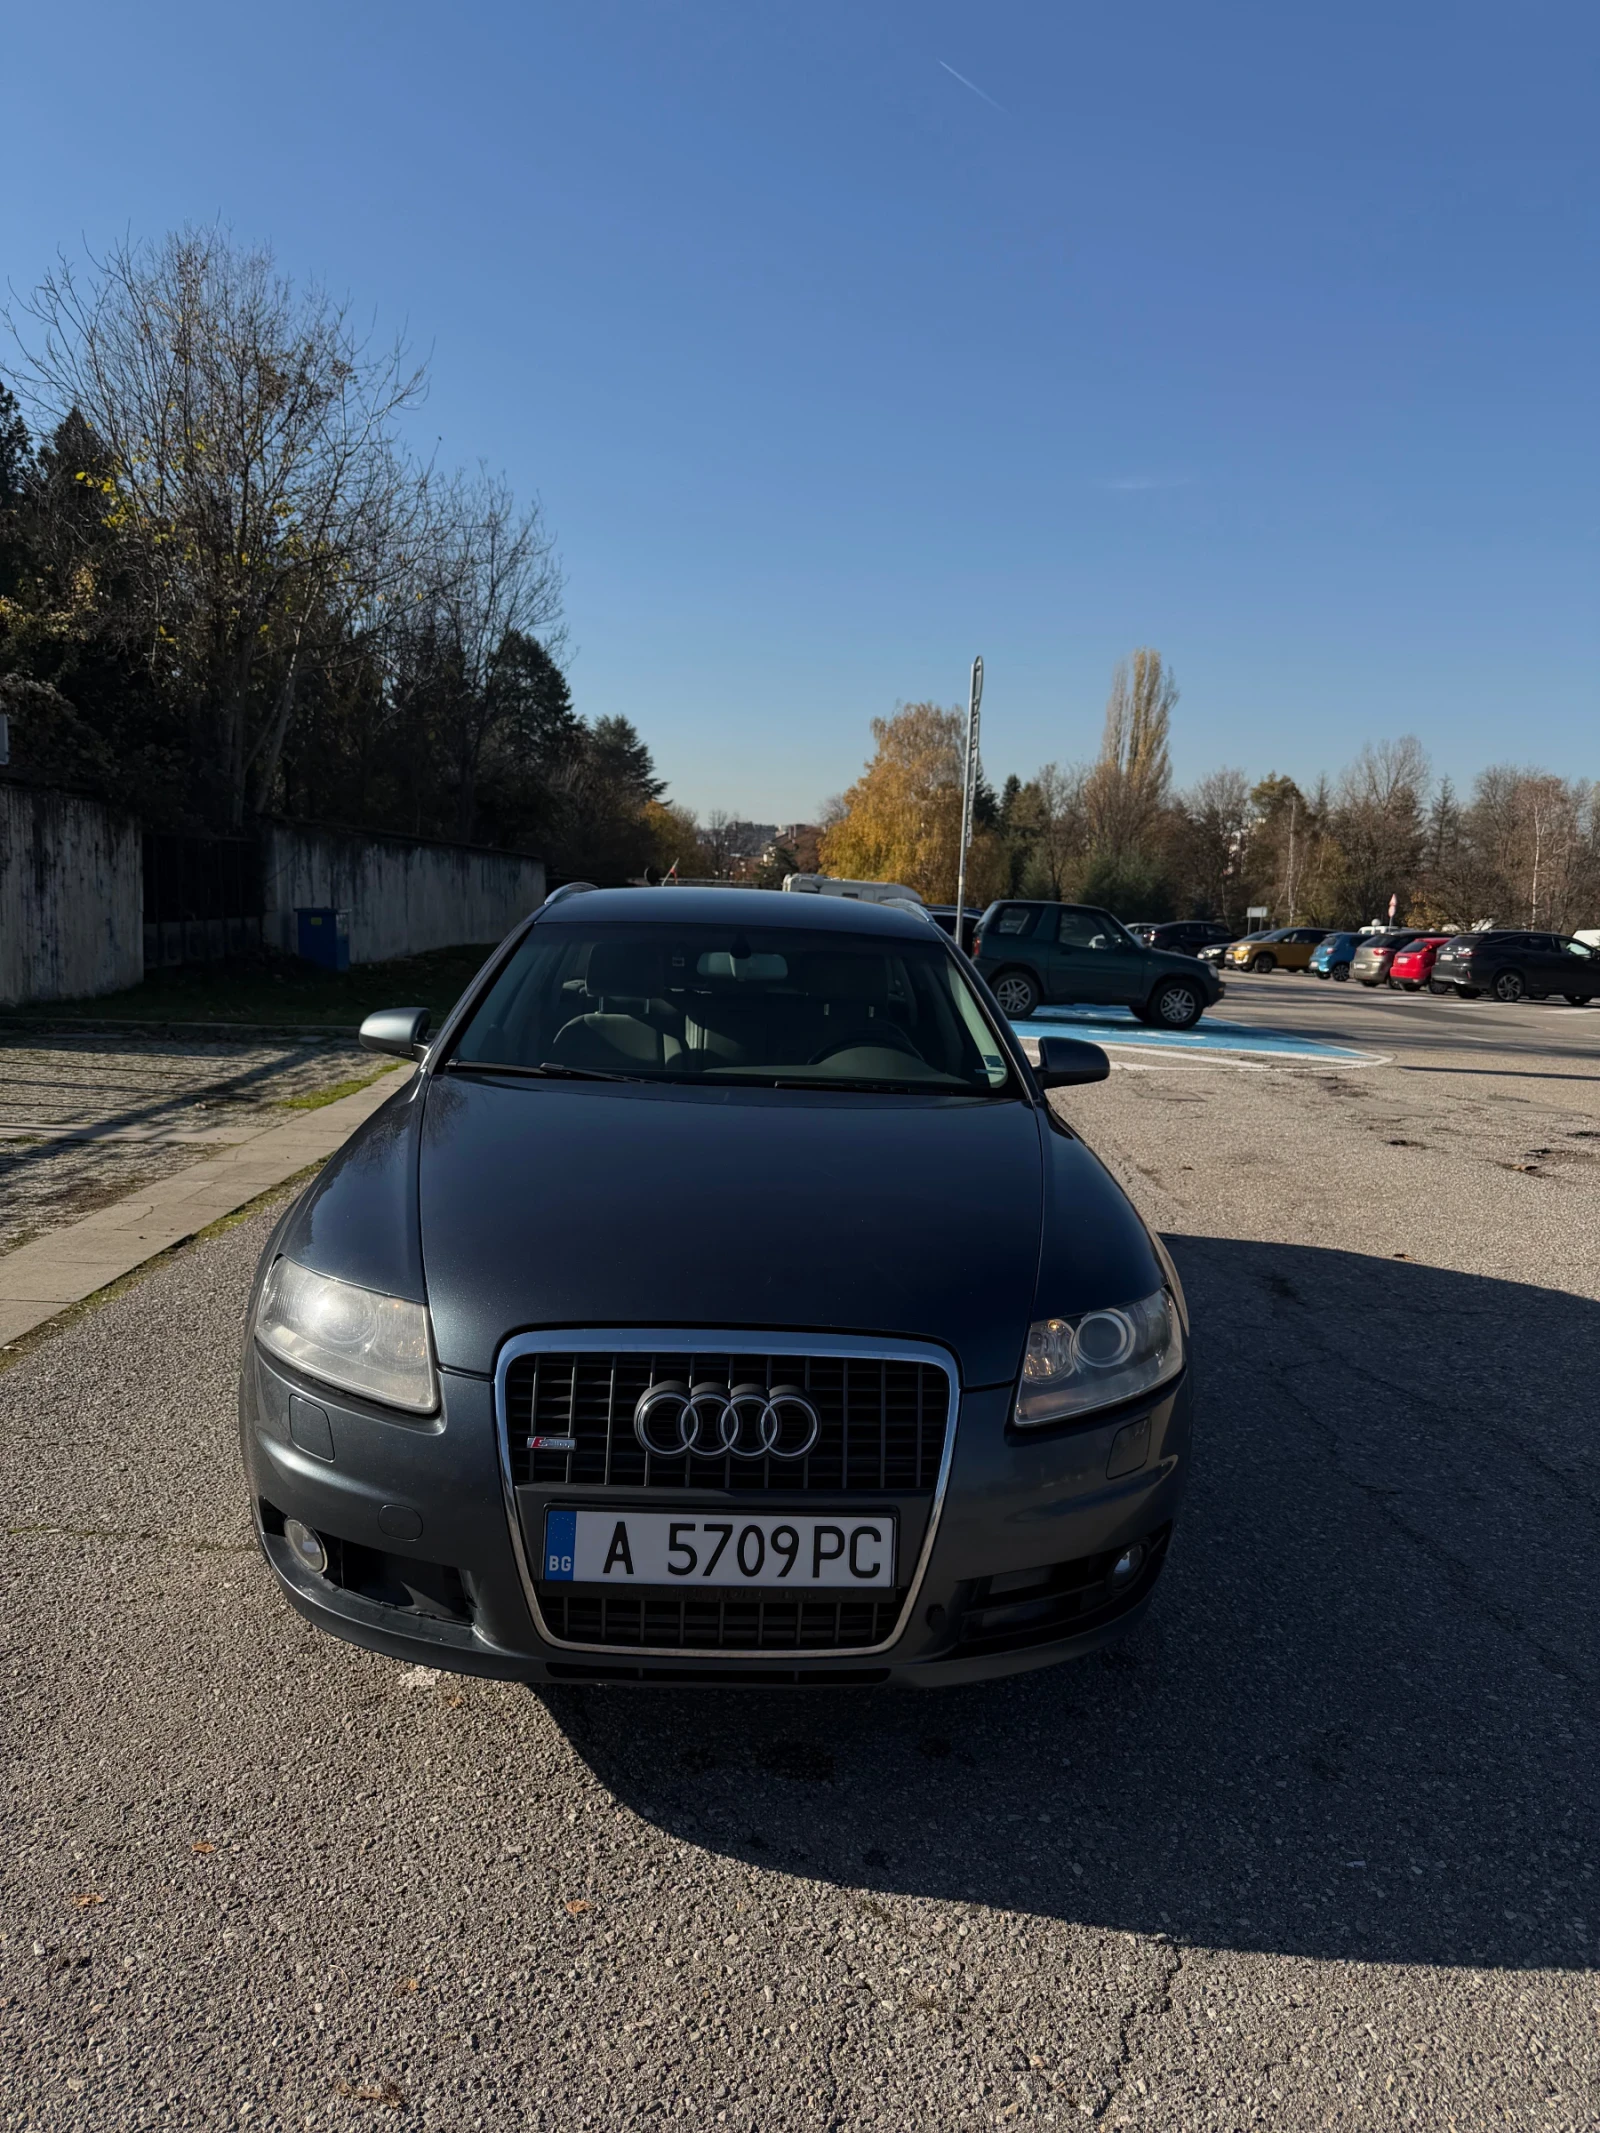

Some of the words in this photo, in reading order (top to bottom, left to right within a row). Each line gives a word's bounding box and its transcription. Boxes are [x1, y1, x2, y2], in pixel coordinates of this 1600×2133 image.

[549, 1555, 571, 1571] BG
[603, 1522, 634, 1575] A
[668, 1523, 800, 1577] 5709
